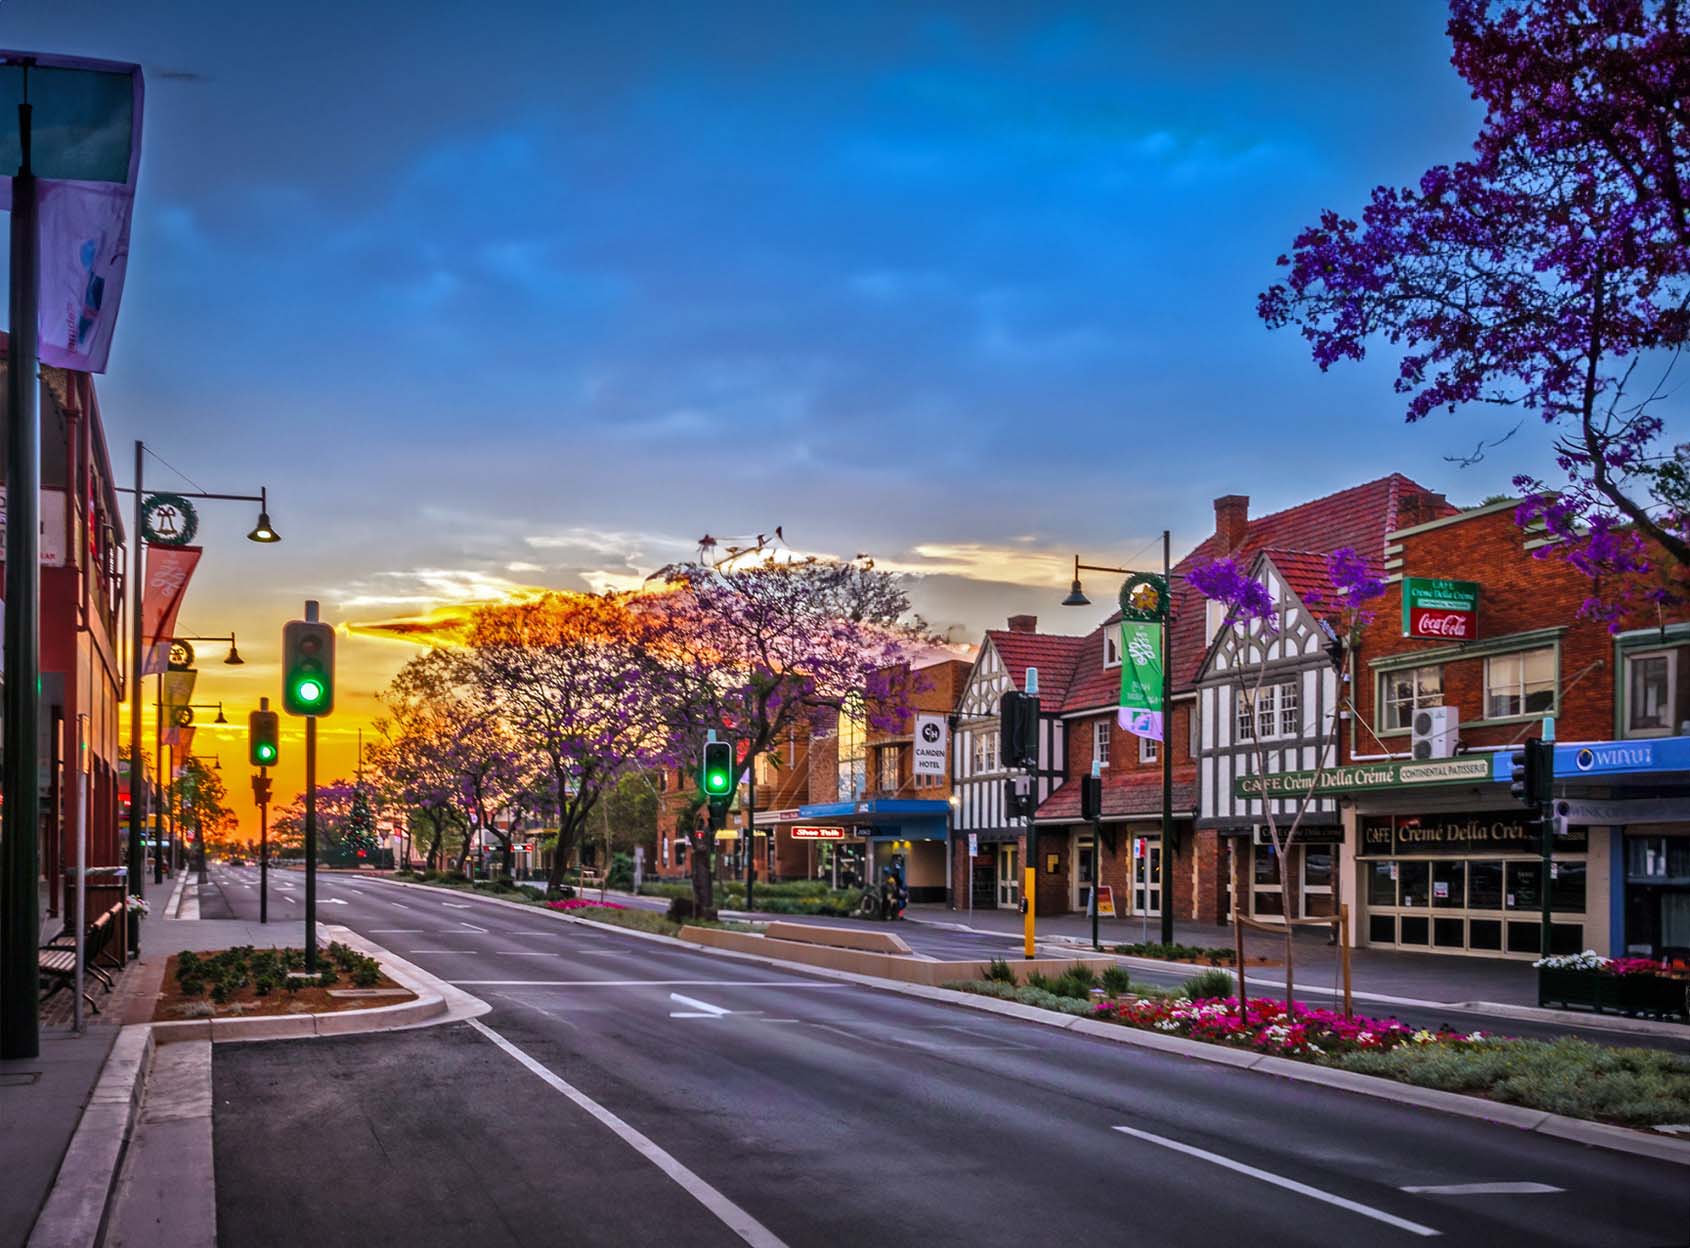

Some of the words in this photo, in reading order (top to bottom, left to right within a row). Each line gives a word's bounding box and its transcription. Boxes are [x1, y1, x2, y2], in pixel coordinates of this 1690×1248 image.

[915, 748, 945, 757] CAMDEN
[919, 760, 940, 769] HOTEL
[1402, 767, 1447, 779] CONTINENTAL
[1242, 777, 1281, 792] CAFE
[1320, 769, 1353, 788] Della
[1366, 827, 1391, 843] CAFE
[1447, 821, 1487, 841] Della
